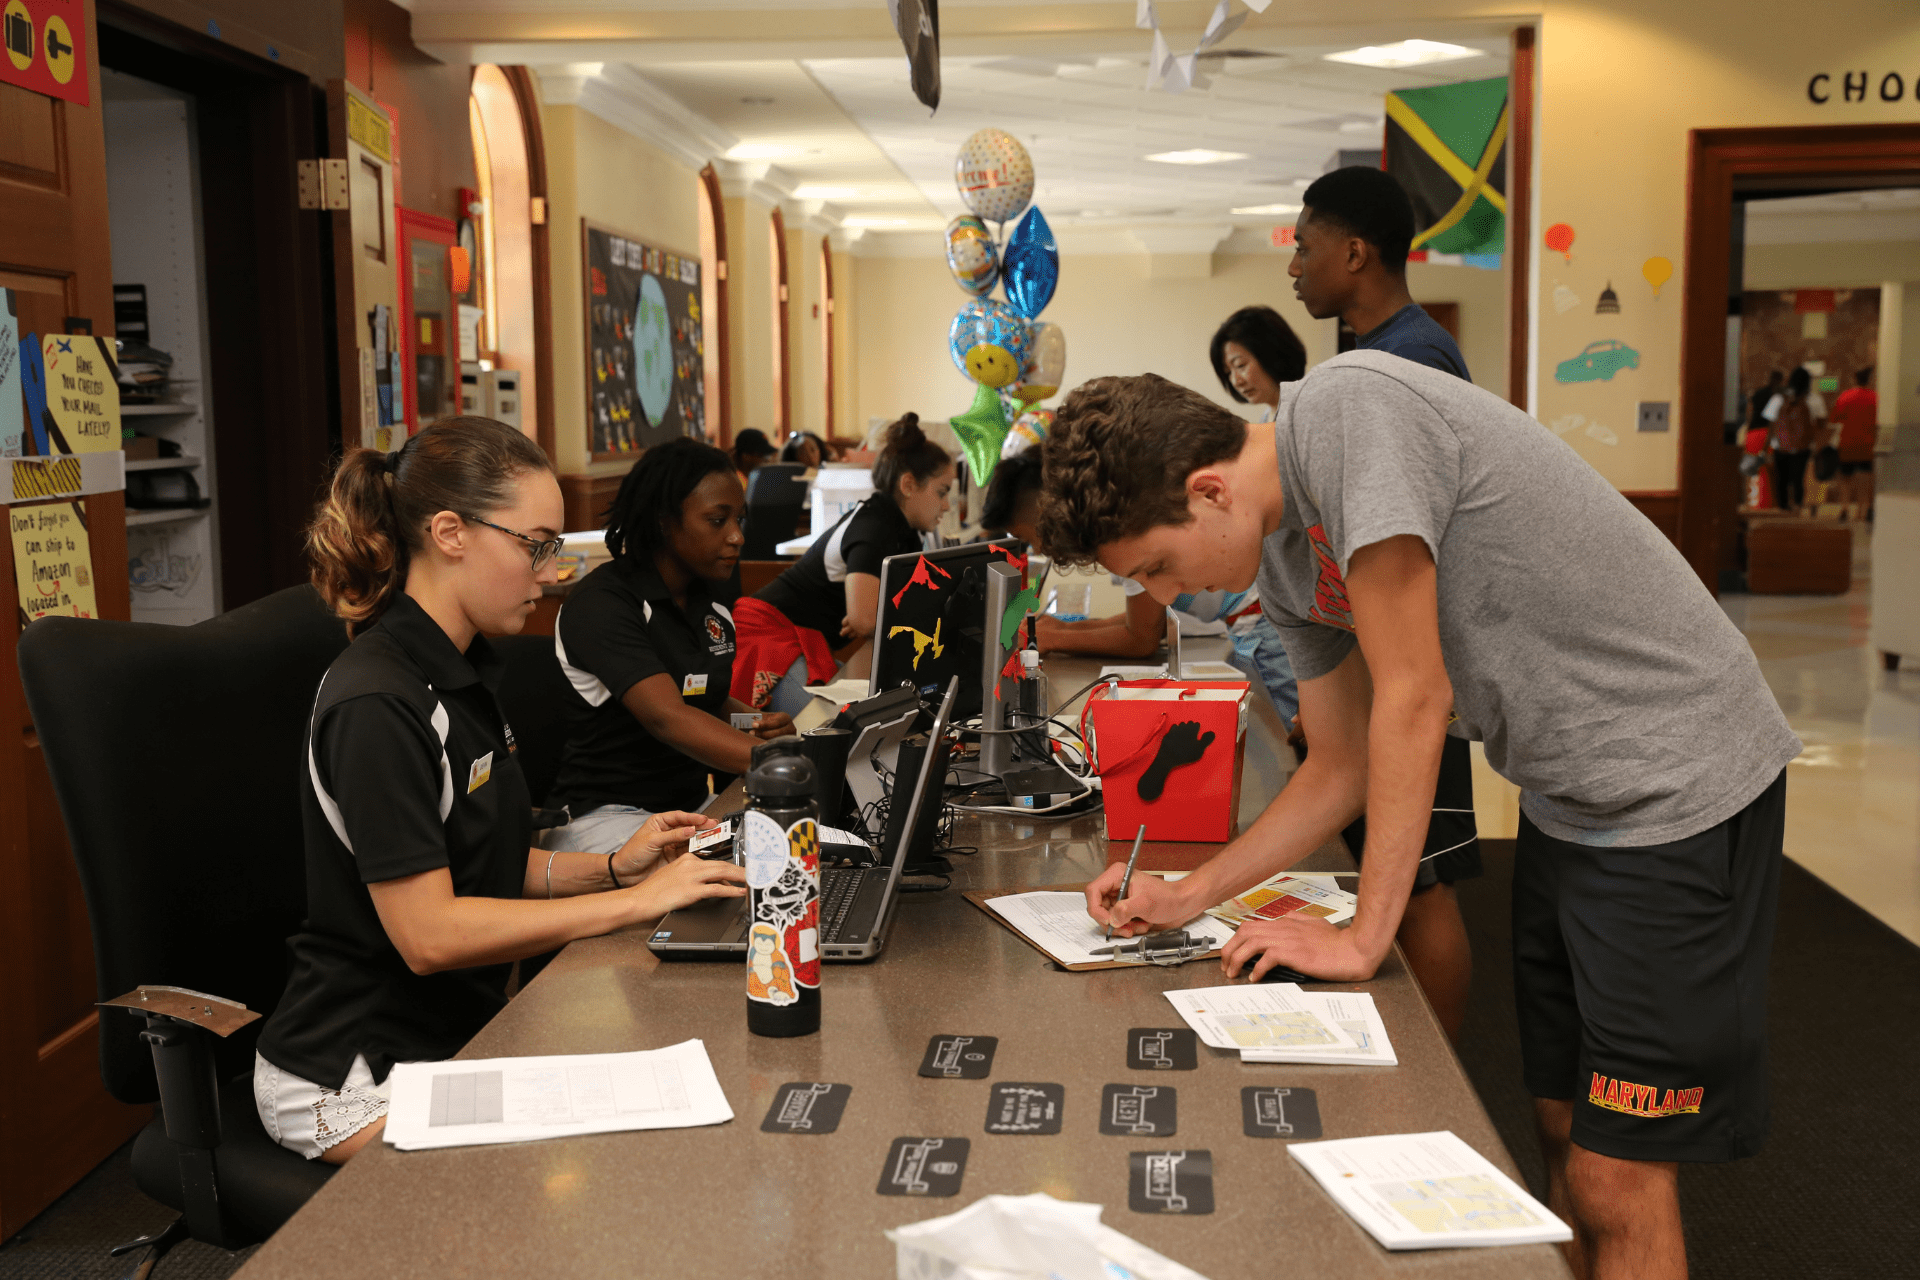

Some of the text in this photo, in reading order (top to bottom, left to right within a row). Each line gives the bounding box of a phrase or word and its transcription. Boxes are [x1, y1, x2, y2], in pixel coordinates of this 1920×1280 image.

[1807, 71, 1920, 105] CHO
[76, 355, 93, 376] HAVE
[62, 373, 76, 391] YOU
[61, 396, 104, 416] YOUR MAIL
[12, 513, 35, 533] Don't
[25, 536, 76, 557] can ship to
[32, 559, 72, 583] Amazon
[26, 592, 59, 614] located
[60, 590, 72, 607] in
[1145, 1040, 1162, 1058] MAIL
[1589, 1071, 1704, 1112] MARYLAND
[1118, 1098, 1140, 1122] KEYS
